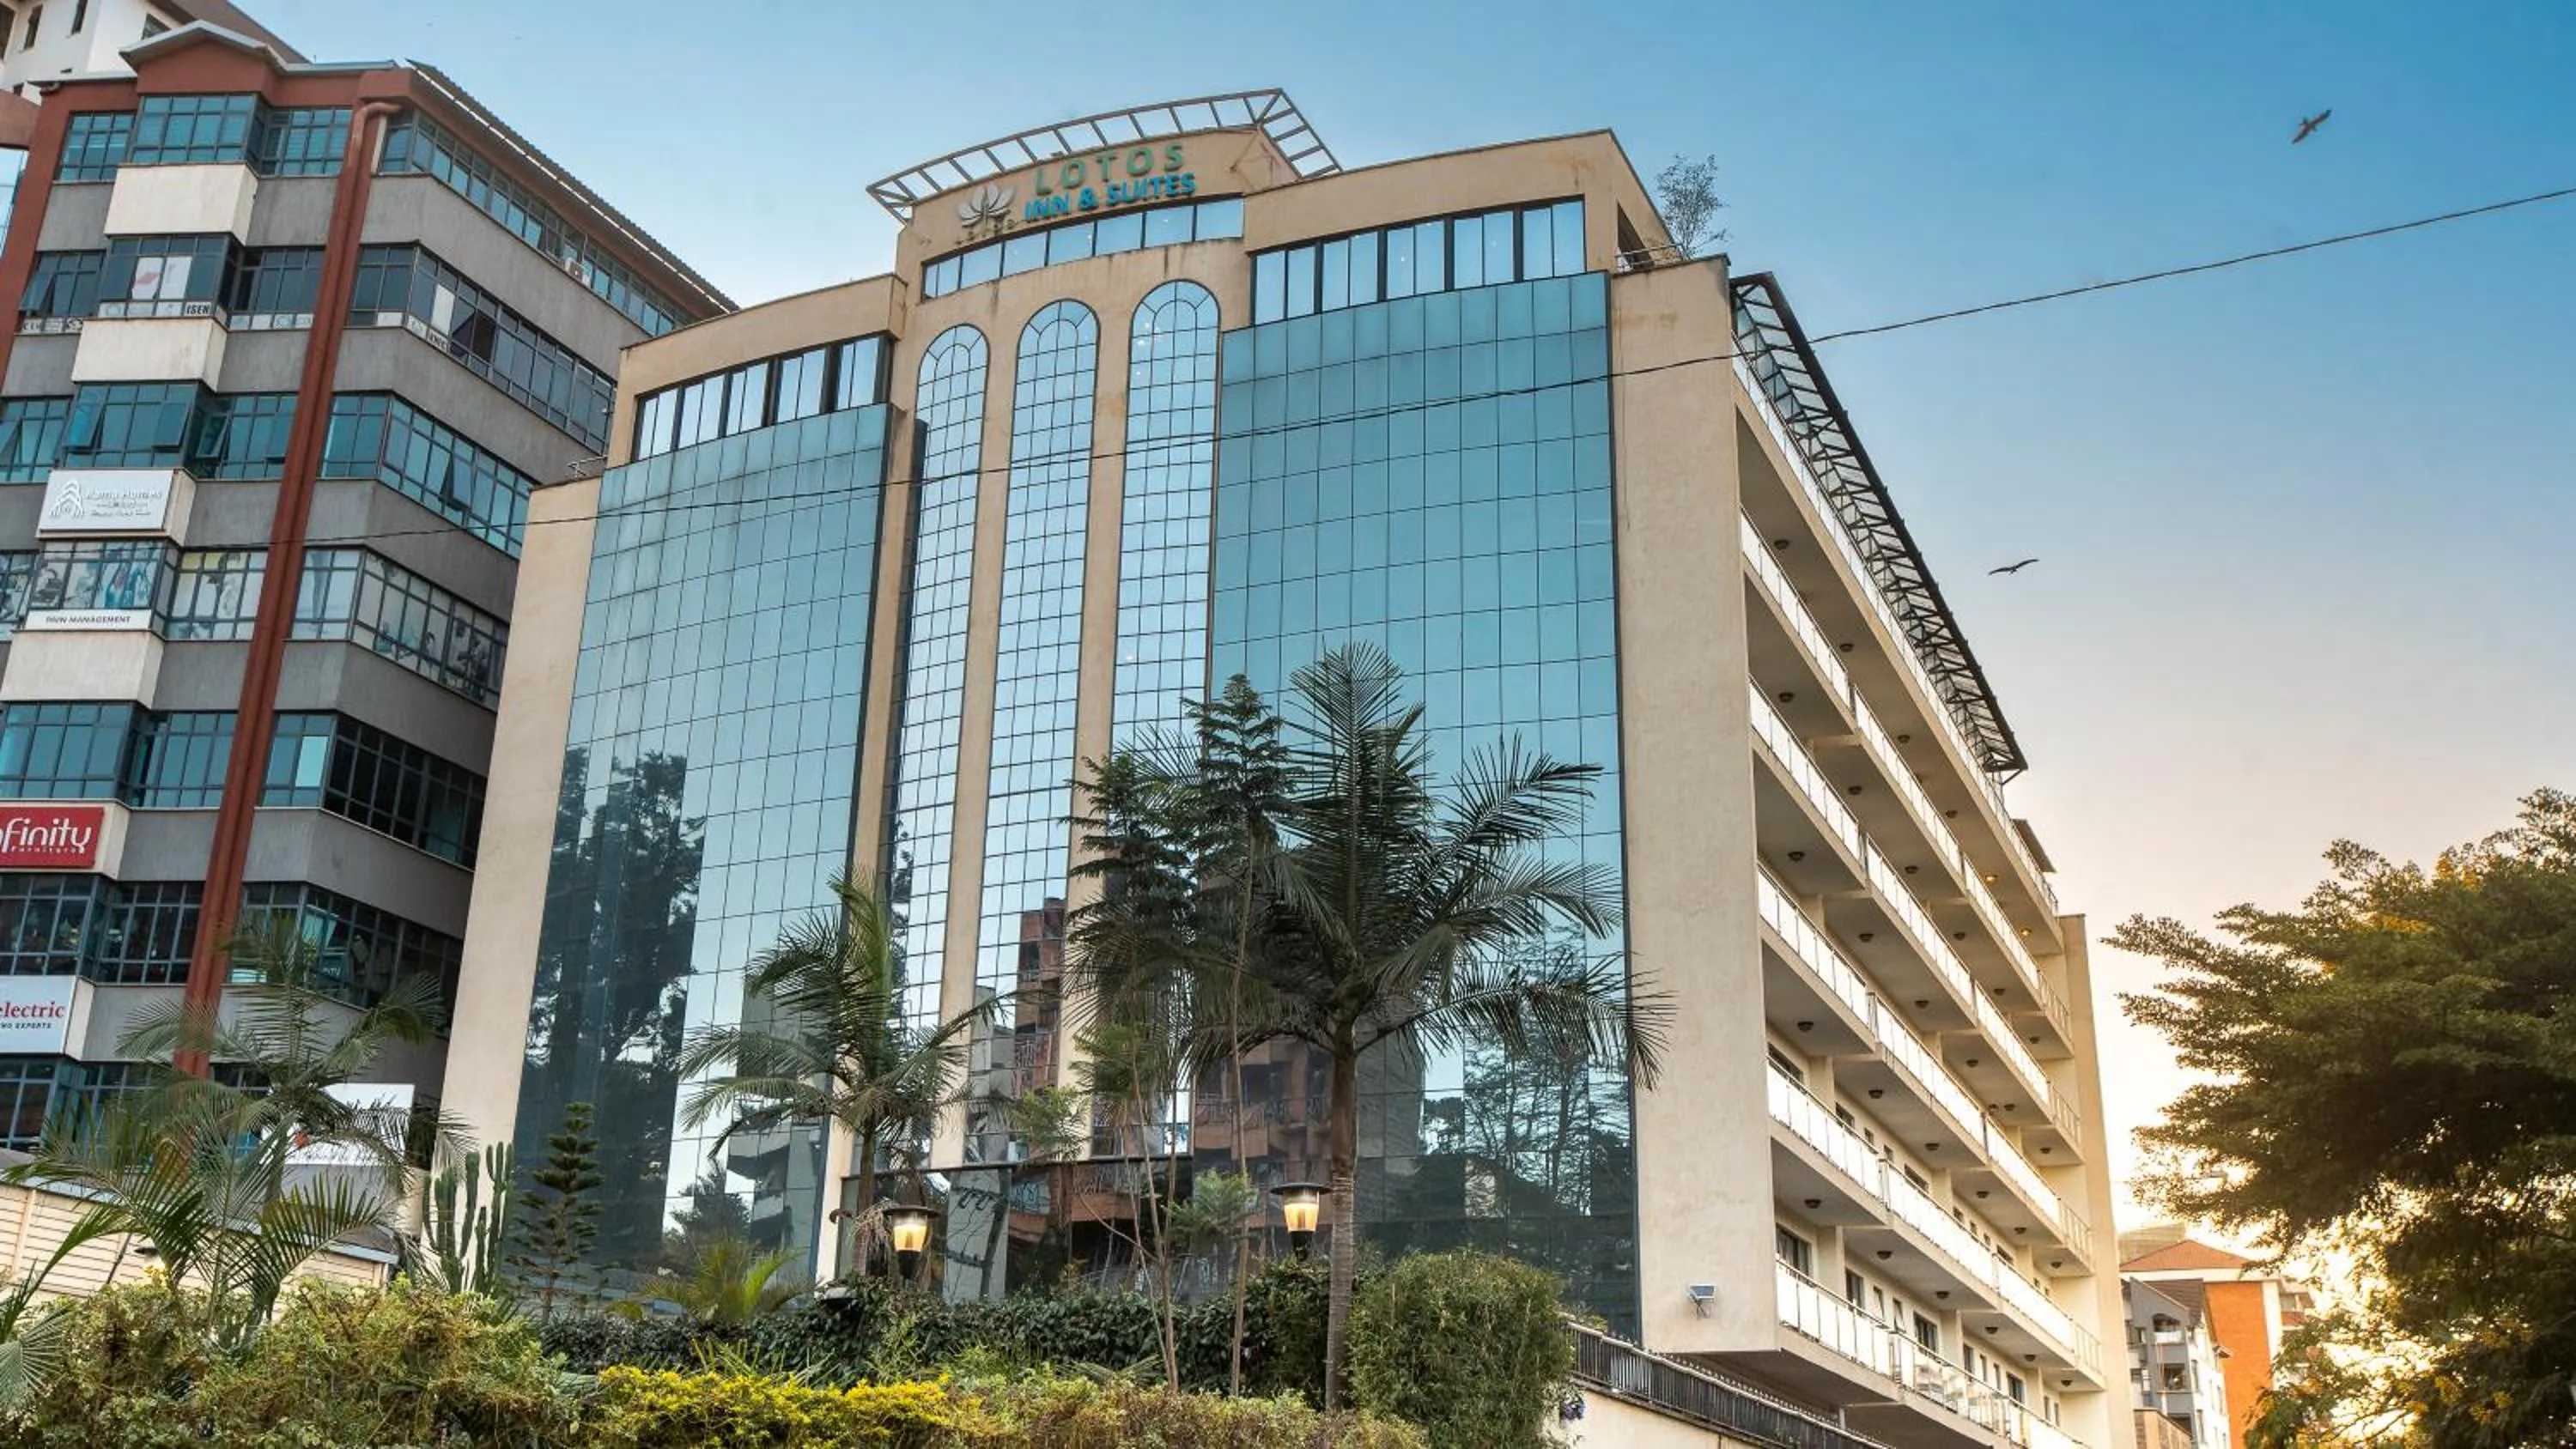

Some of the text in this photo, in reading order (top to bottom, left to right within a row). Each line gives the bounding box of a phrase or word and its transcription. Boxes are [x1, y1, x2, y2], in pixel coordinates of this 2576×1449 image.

[1036, 141, 1184, 196] LOTOS
[1024, 172, 1197, 221] INN & SUITES
[69, 615, 131, 623] MANAGEMENT
[0, 817, 92, 854] finity
